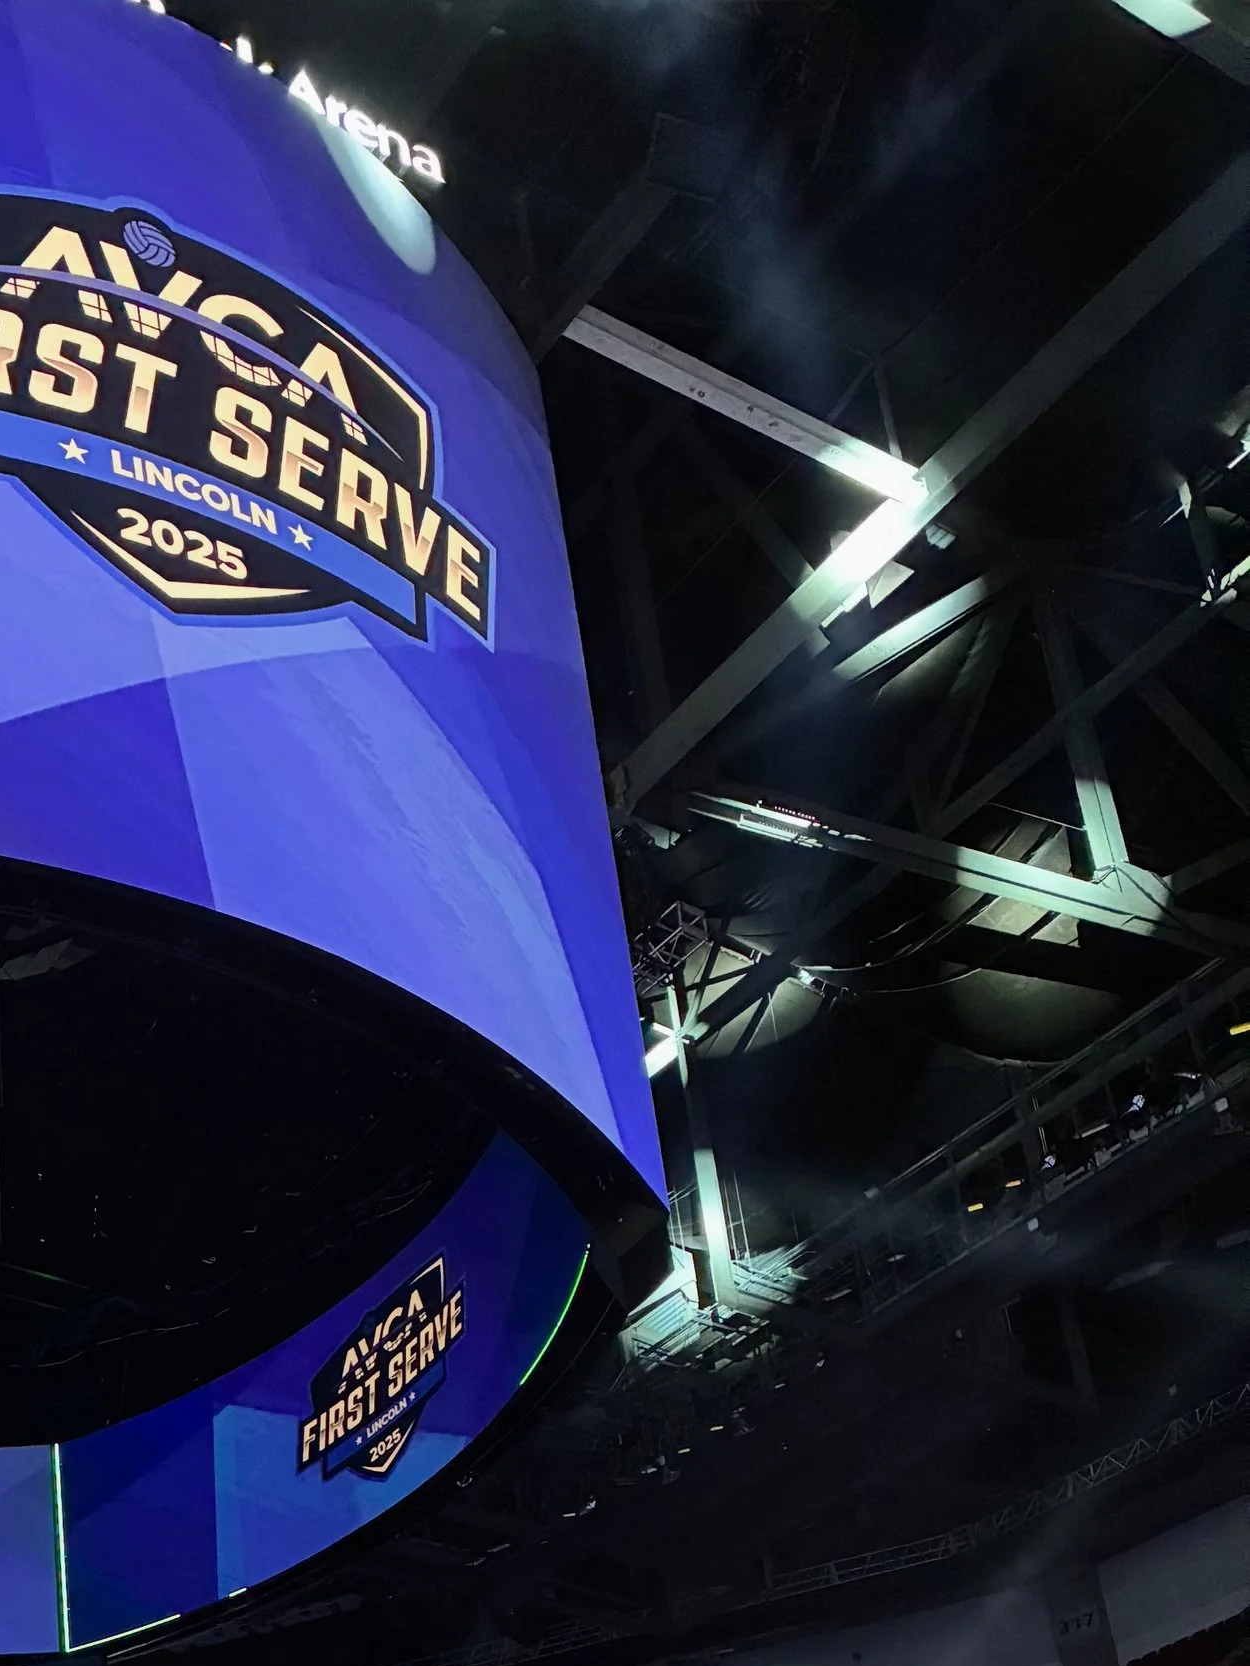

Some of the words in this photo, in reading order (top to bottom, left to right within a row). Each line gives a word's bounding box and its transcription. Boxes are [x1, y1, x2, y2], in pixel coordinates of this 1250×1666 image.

[288, 66, 446, 184] Arena
[0, 225, 368, 445] AVCA
[109, 449, 277, 535] LINCOLN
[210, 387, 482, 621] SERVE
[117, 508, 248, 579] 2025
[302, 1370, 380, 1462] FIRST
[388, 1289, 463, 1398] SERVE
[338, 1288, 427, 1394] AVCA
[366, 1397, 408, 1438] LINCOLN
[369, 1427, 401, 1462] 2025
[1059, 1612, 1094, 1636] 317
